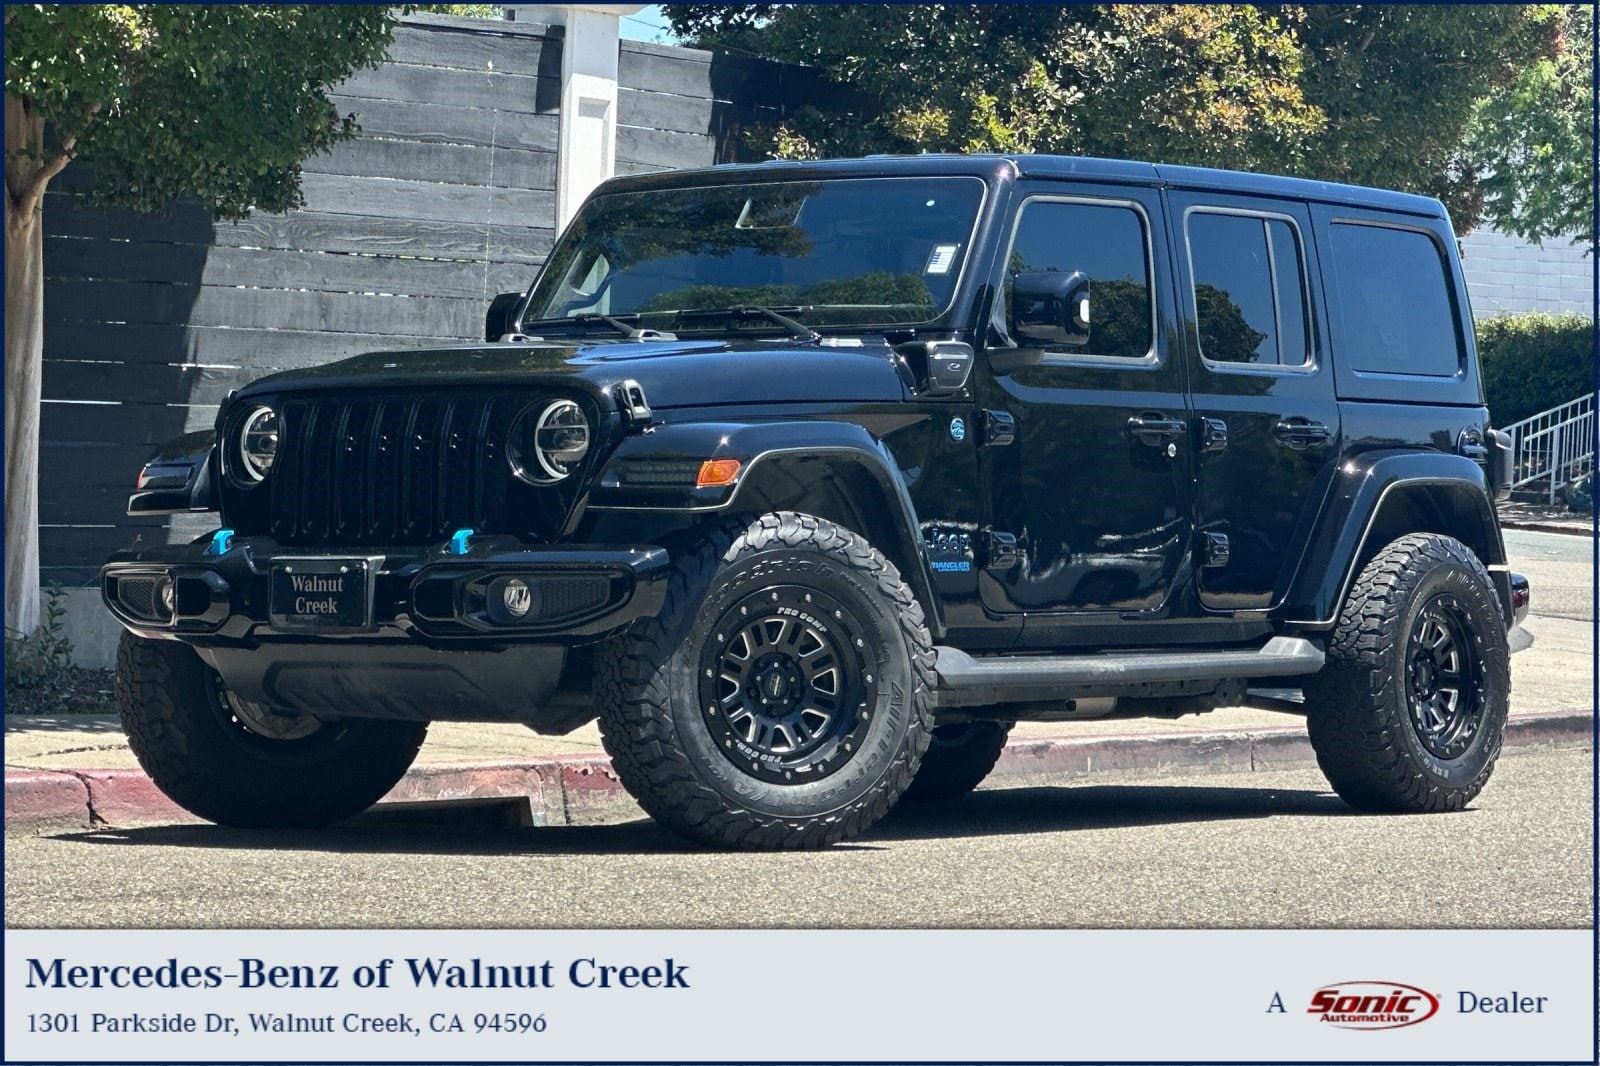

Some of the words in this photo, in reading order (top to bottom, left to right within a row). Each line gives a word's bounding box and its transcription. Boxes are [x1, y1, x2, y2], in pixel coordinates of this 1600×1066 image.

[925, 528, 971, 557] Jeep
[291, 575, 343, 592] Walnut
[295, 597, 337, 614] Creek
[777, 606, 799, 617] PRO
[799, 612, 828, 633] COMP
[735, 739, 760, 758] COM
[760, 753, 782, 763] PRO
